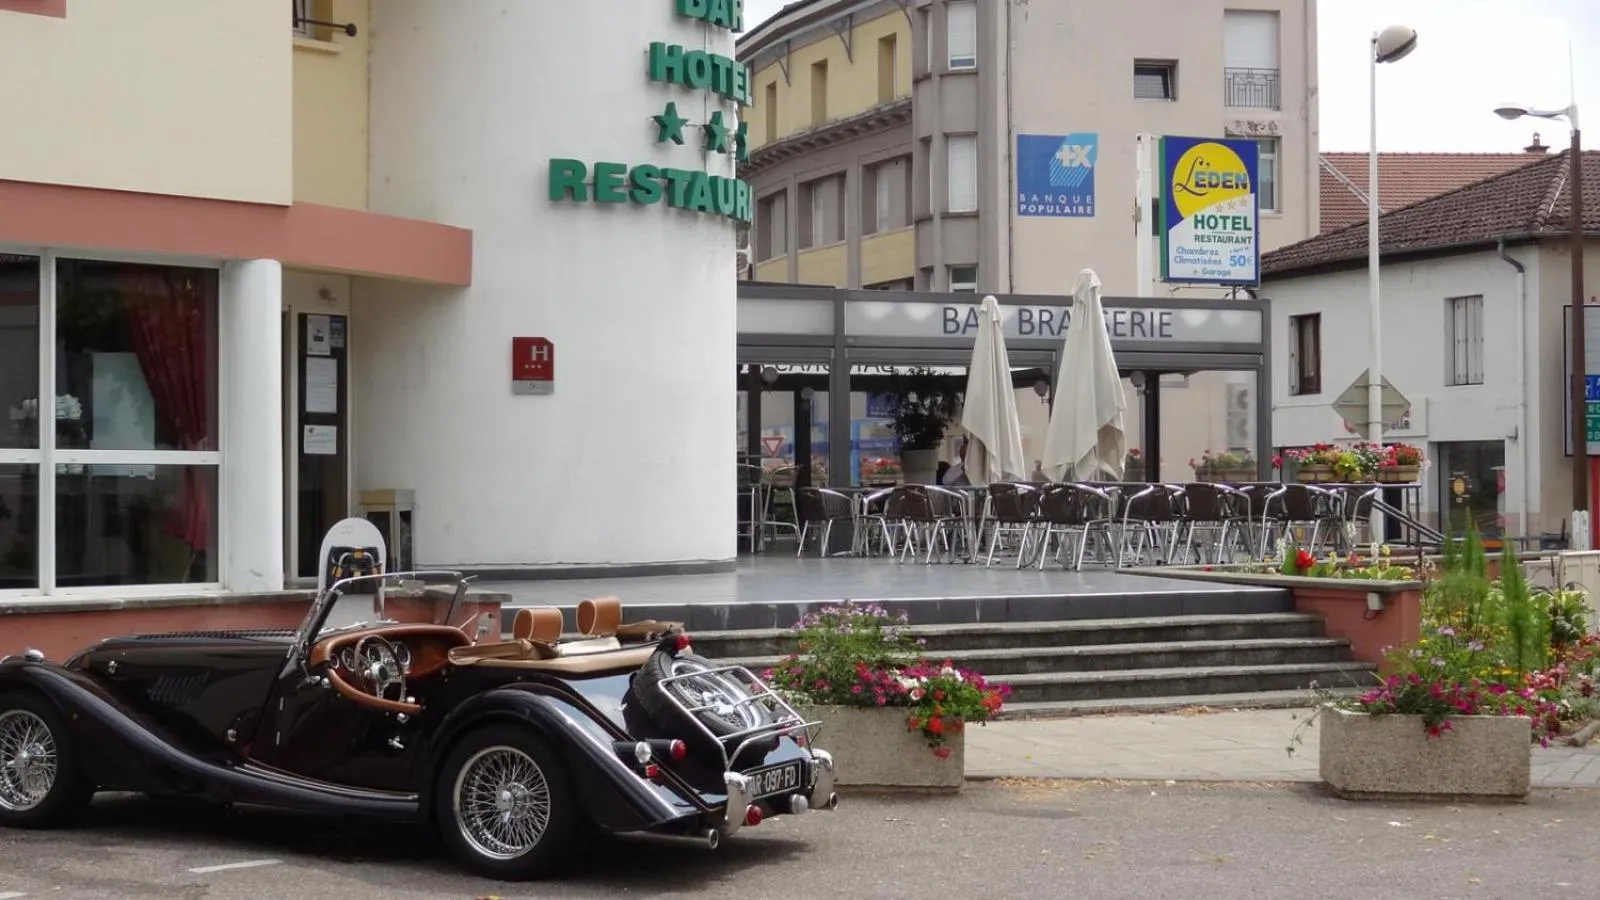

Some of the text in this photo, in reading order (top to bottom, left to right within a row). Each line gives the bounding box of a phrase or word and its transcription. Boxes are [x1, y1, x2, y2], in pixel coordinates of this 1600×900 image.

[649, 41, 752, 107] HOTEL
[549, 158, 753, 226] RESTAUR
[1019, 193, 1093, 205] BANQUE
[1019, 204, 1093, 215] POPULAIRE
[1193, 214, 1253, 231] HOTEL
[1193, 234, 1253, 244] RESTAURANT
[1176, 246, 1219, 256] Chambres
[1201, 267, 1232, 277] Garage
[942, 307, 1173, 338] BA BRAERIE
[531, 345, 549, 361] H
